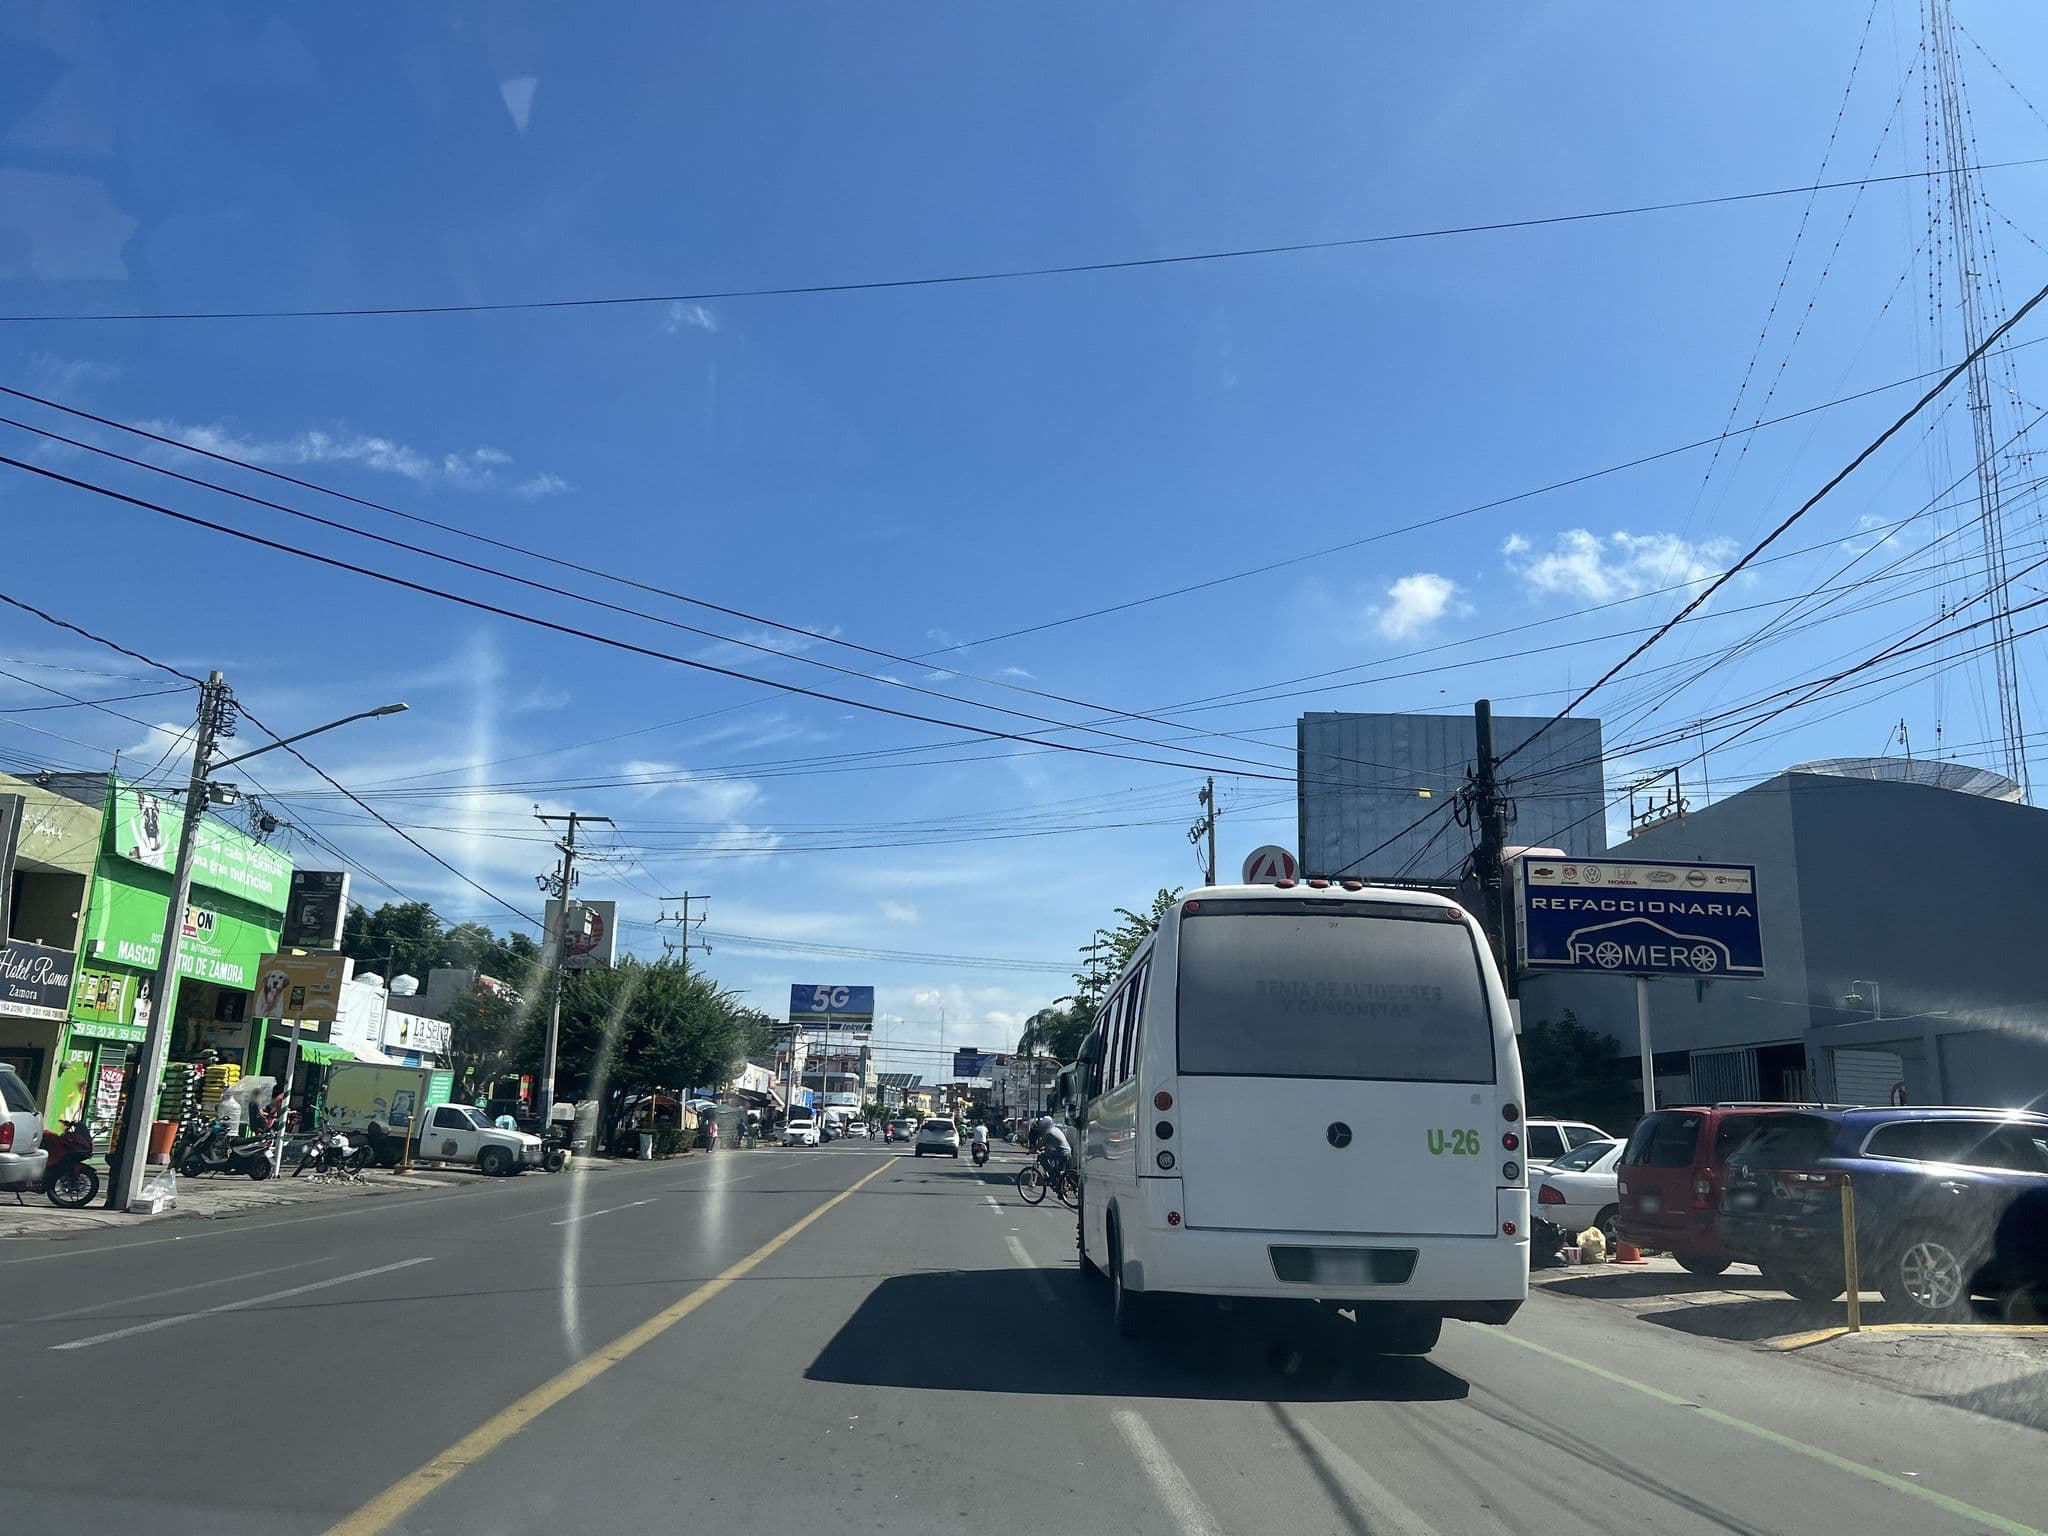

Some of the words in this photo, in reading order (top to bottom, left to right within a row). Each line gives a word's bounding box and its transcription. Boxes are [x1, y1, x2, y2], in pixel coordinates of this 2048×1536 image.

[1532, 898, 1752, 918] REFACCIONARIA
[0, 948, 33, 981] Hotel
[31, 956, 70, 987] Roma
[196, 957, 208, 977] DE
[208, 960, 244, 983] ZAMORA
[1575, 941, 1718, 973] ROMERO
[8, 984, 38, 1000] Zamora
[810, 985, 850, 1012] 5G
[413, 1017, 425, 1039] La
[1426, 1128, 1481, 1155] U-26
